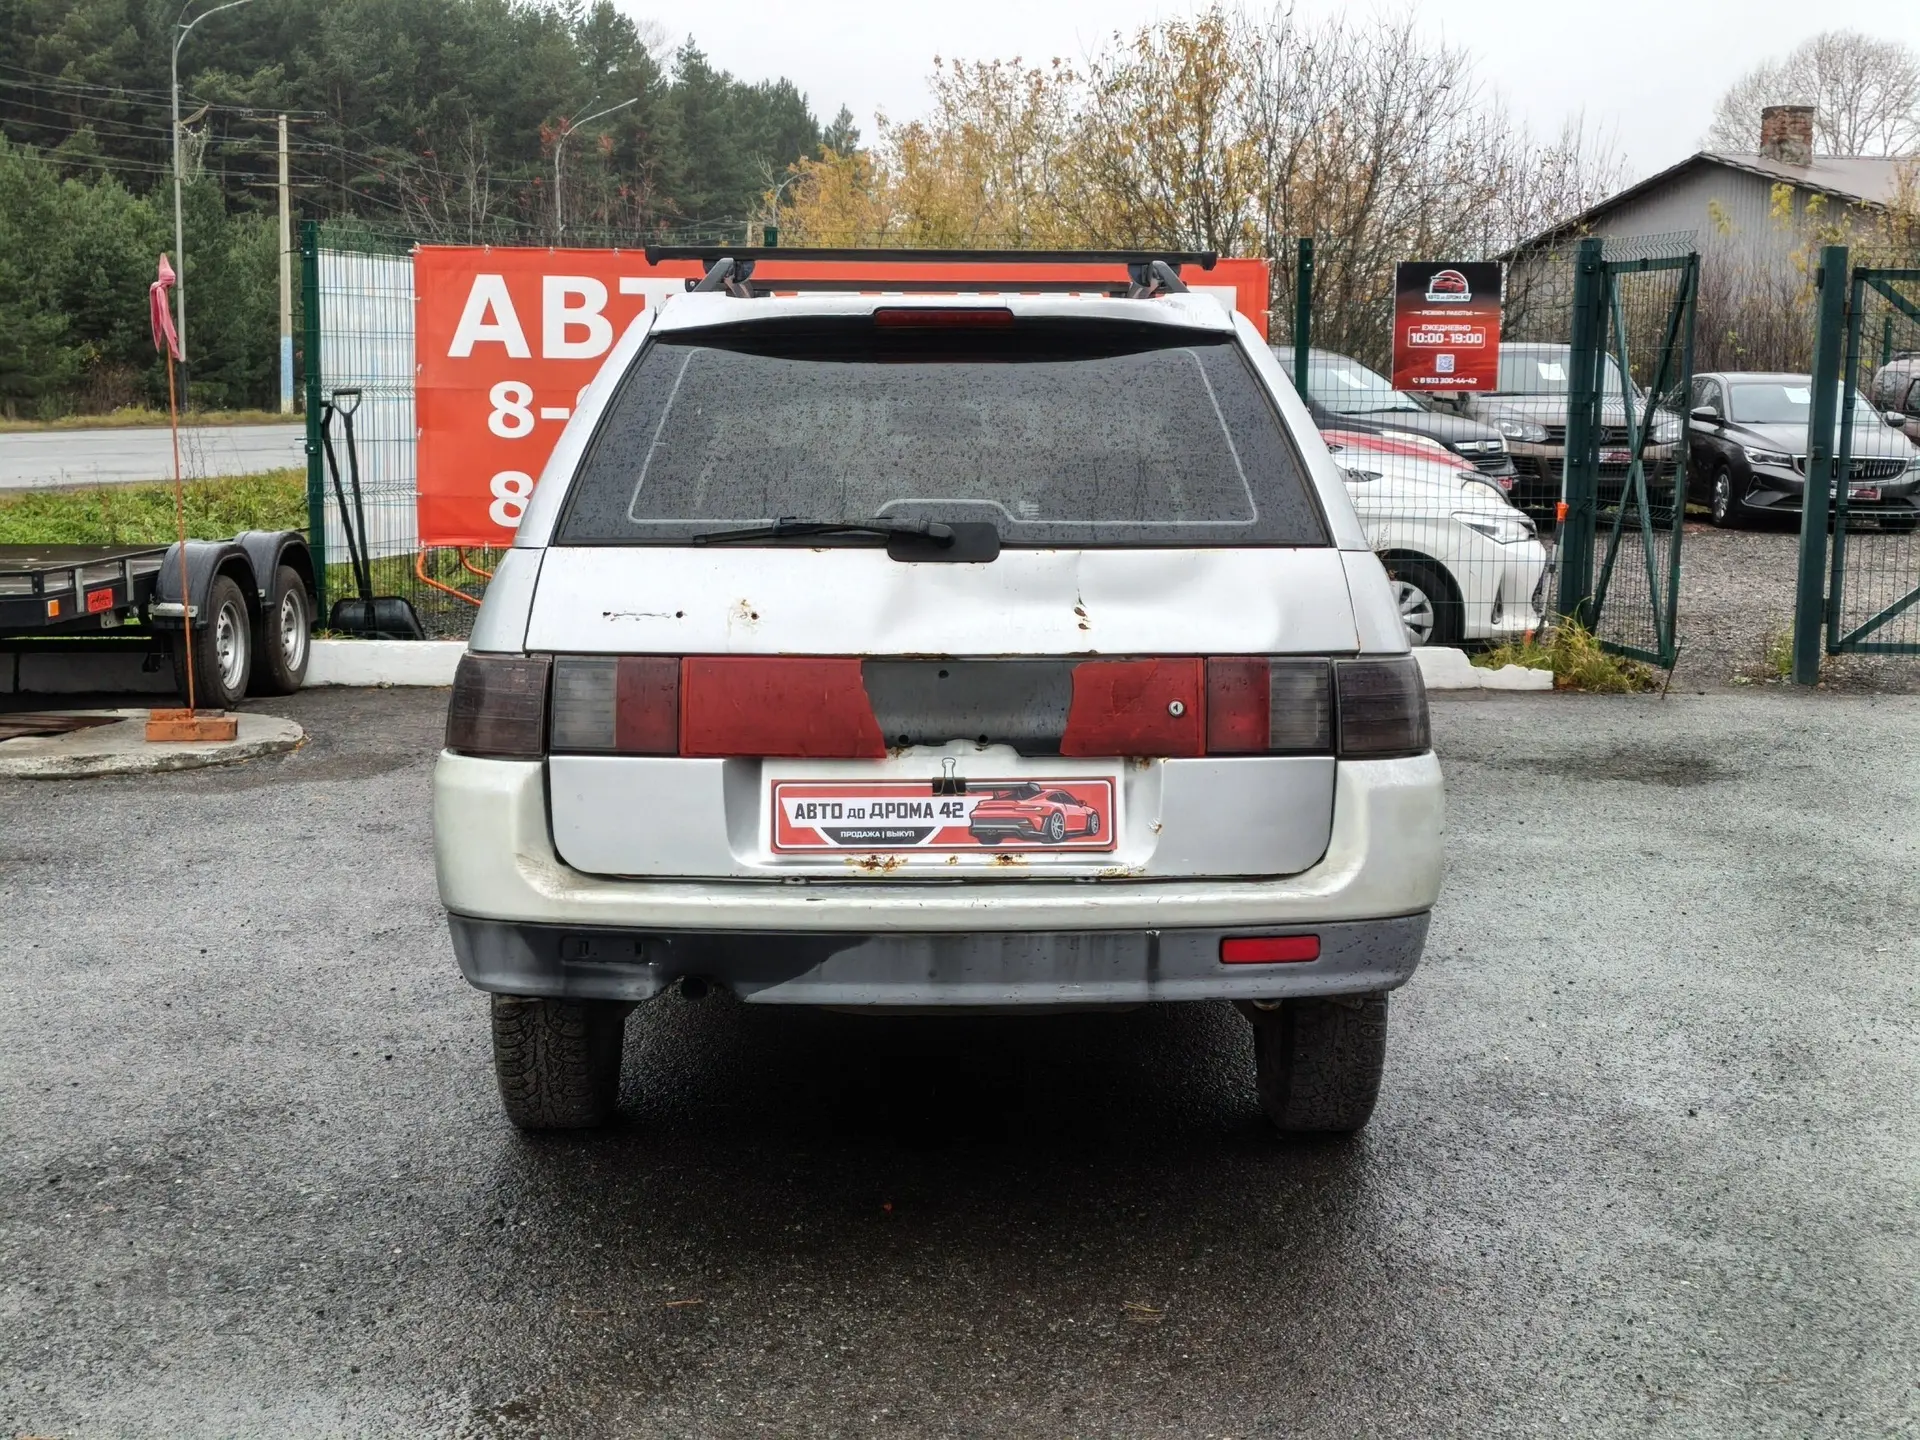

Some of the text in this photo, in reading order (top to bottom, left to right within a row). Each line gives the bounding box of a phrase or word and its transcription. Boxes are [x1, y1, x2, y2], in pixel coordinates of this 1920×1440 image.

[795, 803, 843, 820] АВТО
[869, 802, 934, 820] ДРОМА
[939, 802, 964, 819] 42
